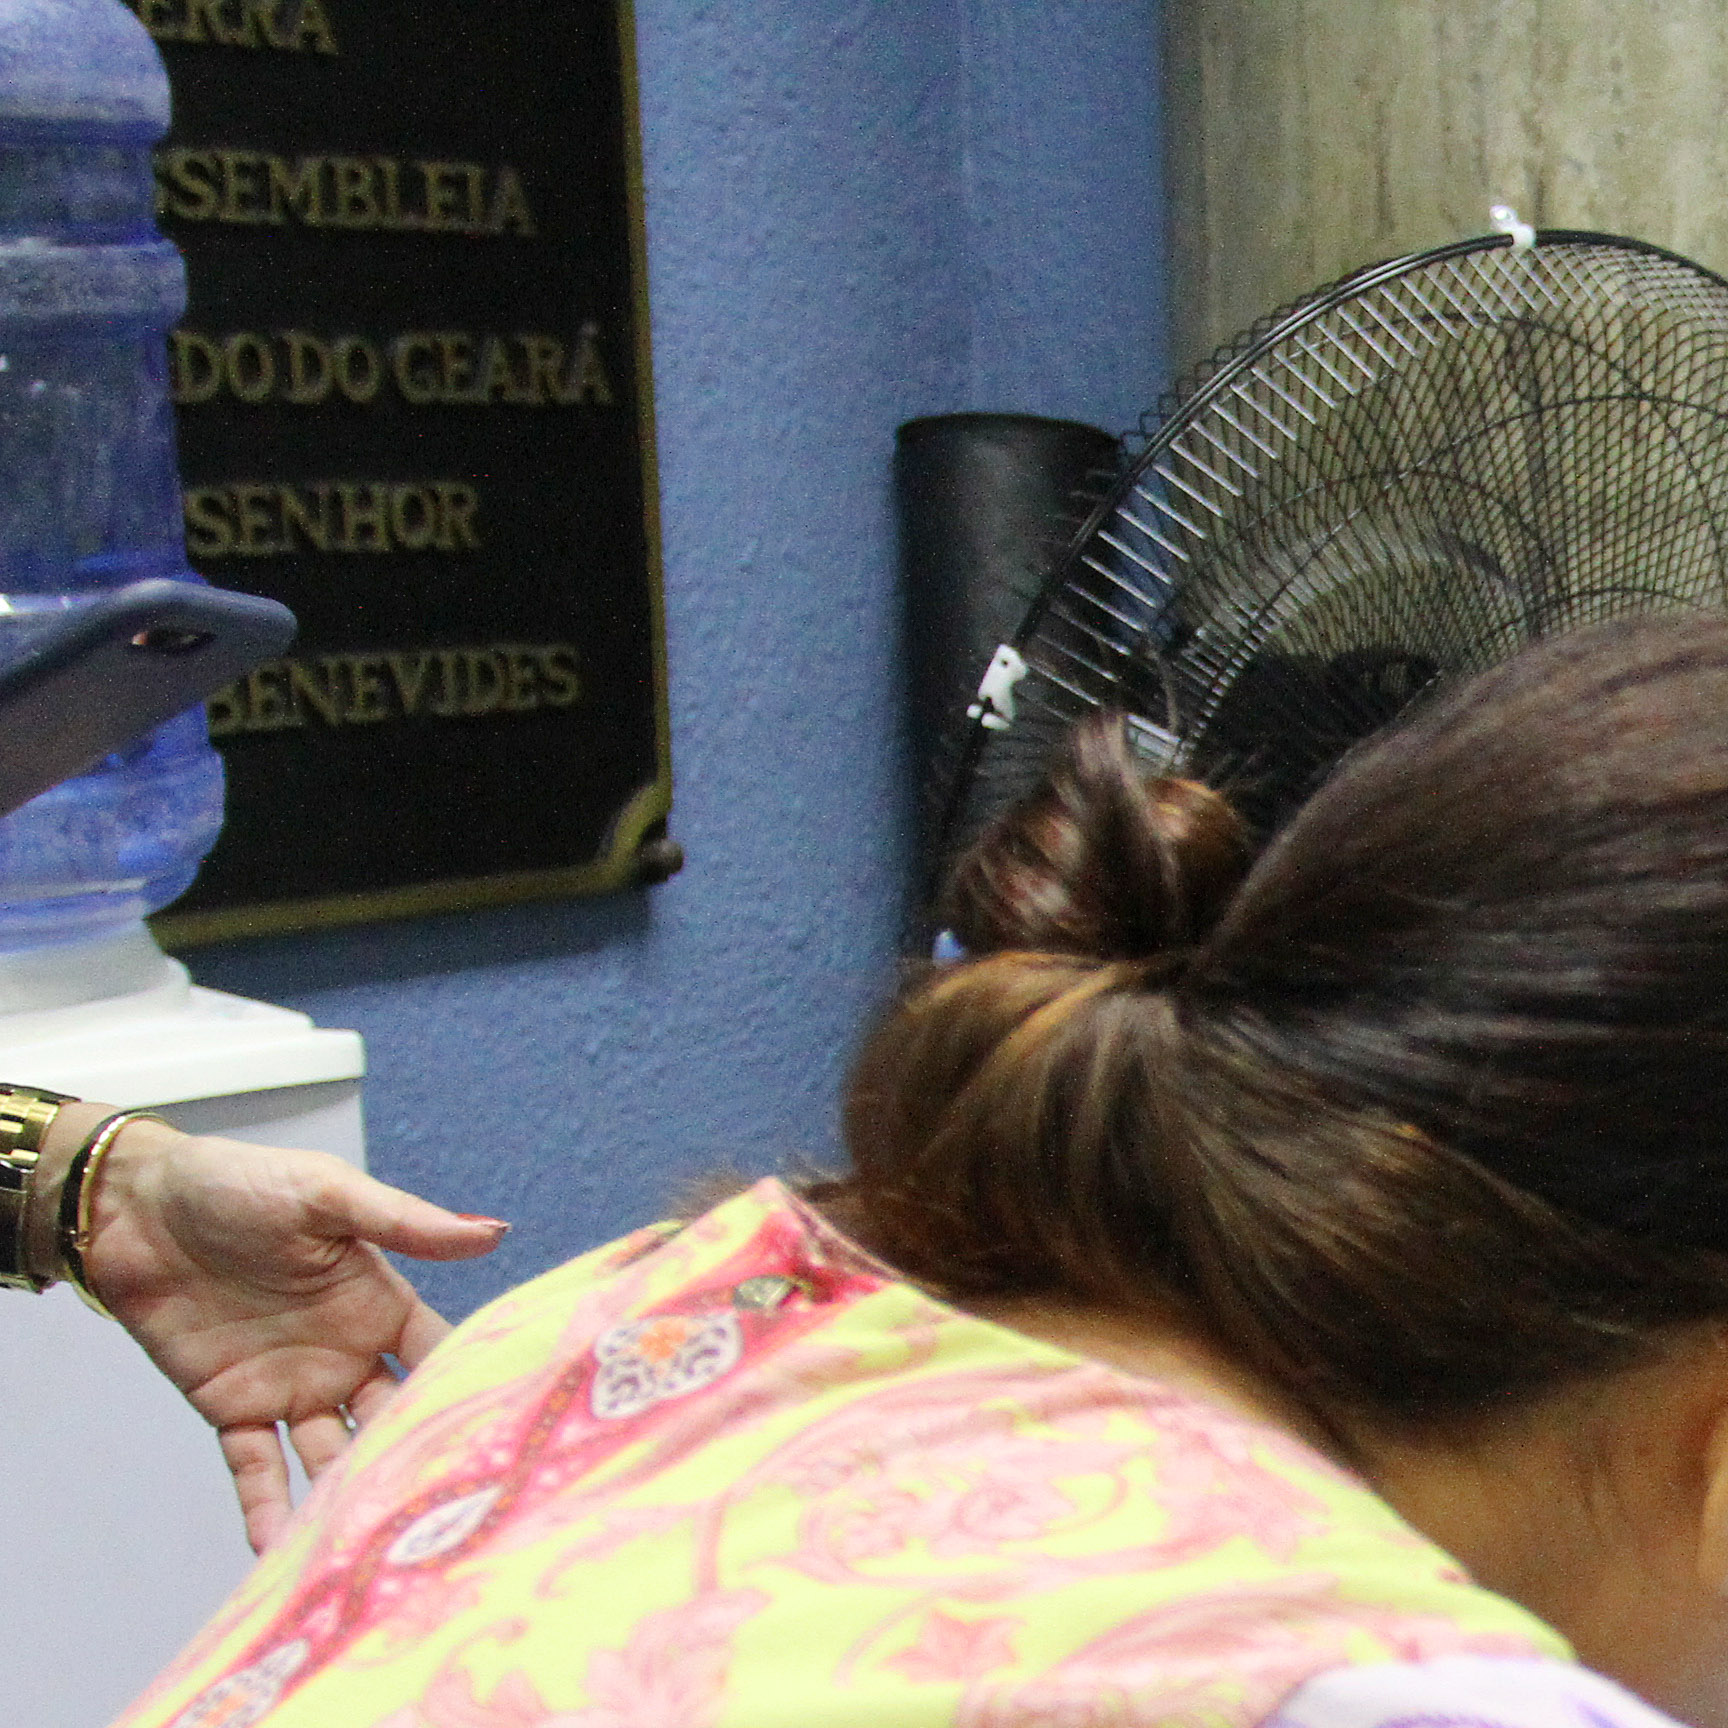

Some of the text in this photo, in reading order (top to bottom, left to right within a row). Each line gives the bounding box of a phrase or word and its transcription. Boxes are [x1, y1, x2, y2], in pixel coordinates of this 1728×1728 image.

[154, 146, 538, 236] SEMBLEIA
[283, 328, 381, 405] DO
[388, 323, 611, 406] CEARÁ
[186, 482, 482, 556] SENHOR
[206, 642, 584, 735] BENEVIDES
